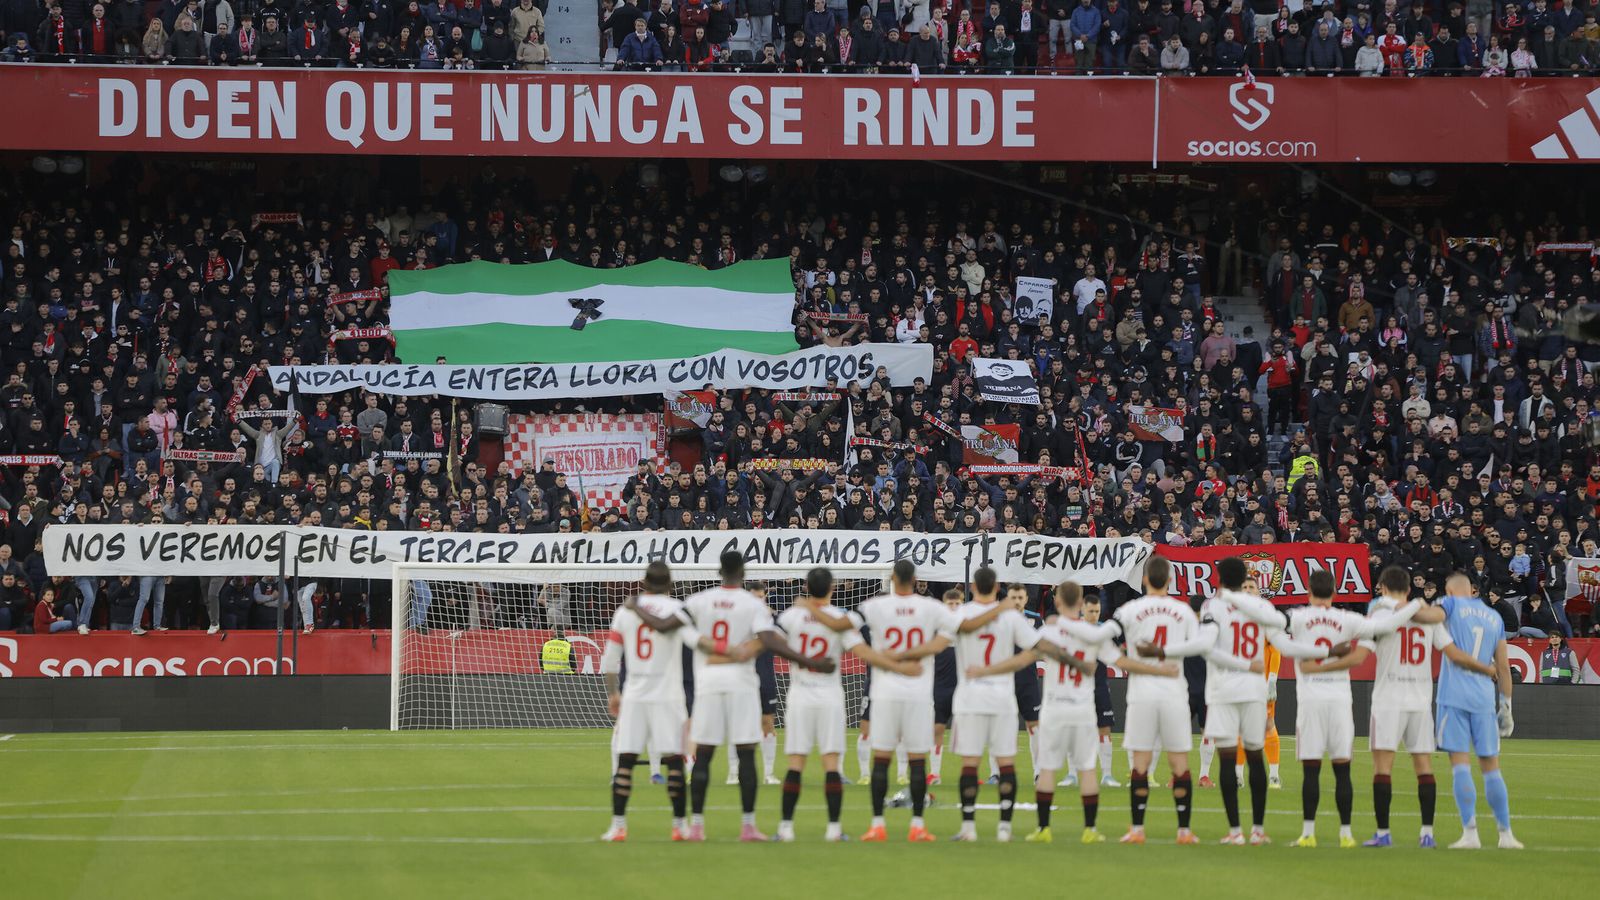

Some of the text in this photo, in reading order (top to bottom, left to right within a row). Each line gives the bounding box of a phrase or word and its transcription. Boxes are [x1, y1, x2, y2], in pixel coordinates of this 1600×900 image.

[98, 78, 1036, 149] DICEN QUE NUNCA SE RINDE
[1187, 140, 1317, 158] SOCIOS.com
[275, 352, 875, 391] ANDALUCÍA ENTERA LLORA CON VOSOTROS
[1129, 412, 1183, 426] TRIANA
[173, 451, 235, 461] ULTRAS BIRIS
[963, 439, 1018, 449] TRIANA
[61, 532, 126, 563] NOS
[139, 531, 281, 563] VEREMOS
[298, 532, 339, 563] EN
[349, 534, 387, 564] EL
[399, 536, 519, 563] TERCER
[893, 537, 951, 567] POR
[636, 623, 654, 660] 6
[799, 633, 829, 672] 12
[885, 627, 924, 650] 20
[978, 633, 997, 667] 7
[1230, 621, 1260, 660] 18
[1396, 627, 1426, 666] 16
[1472, 626, 1485, 661] 1
